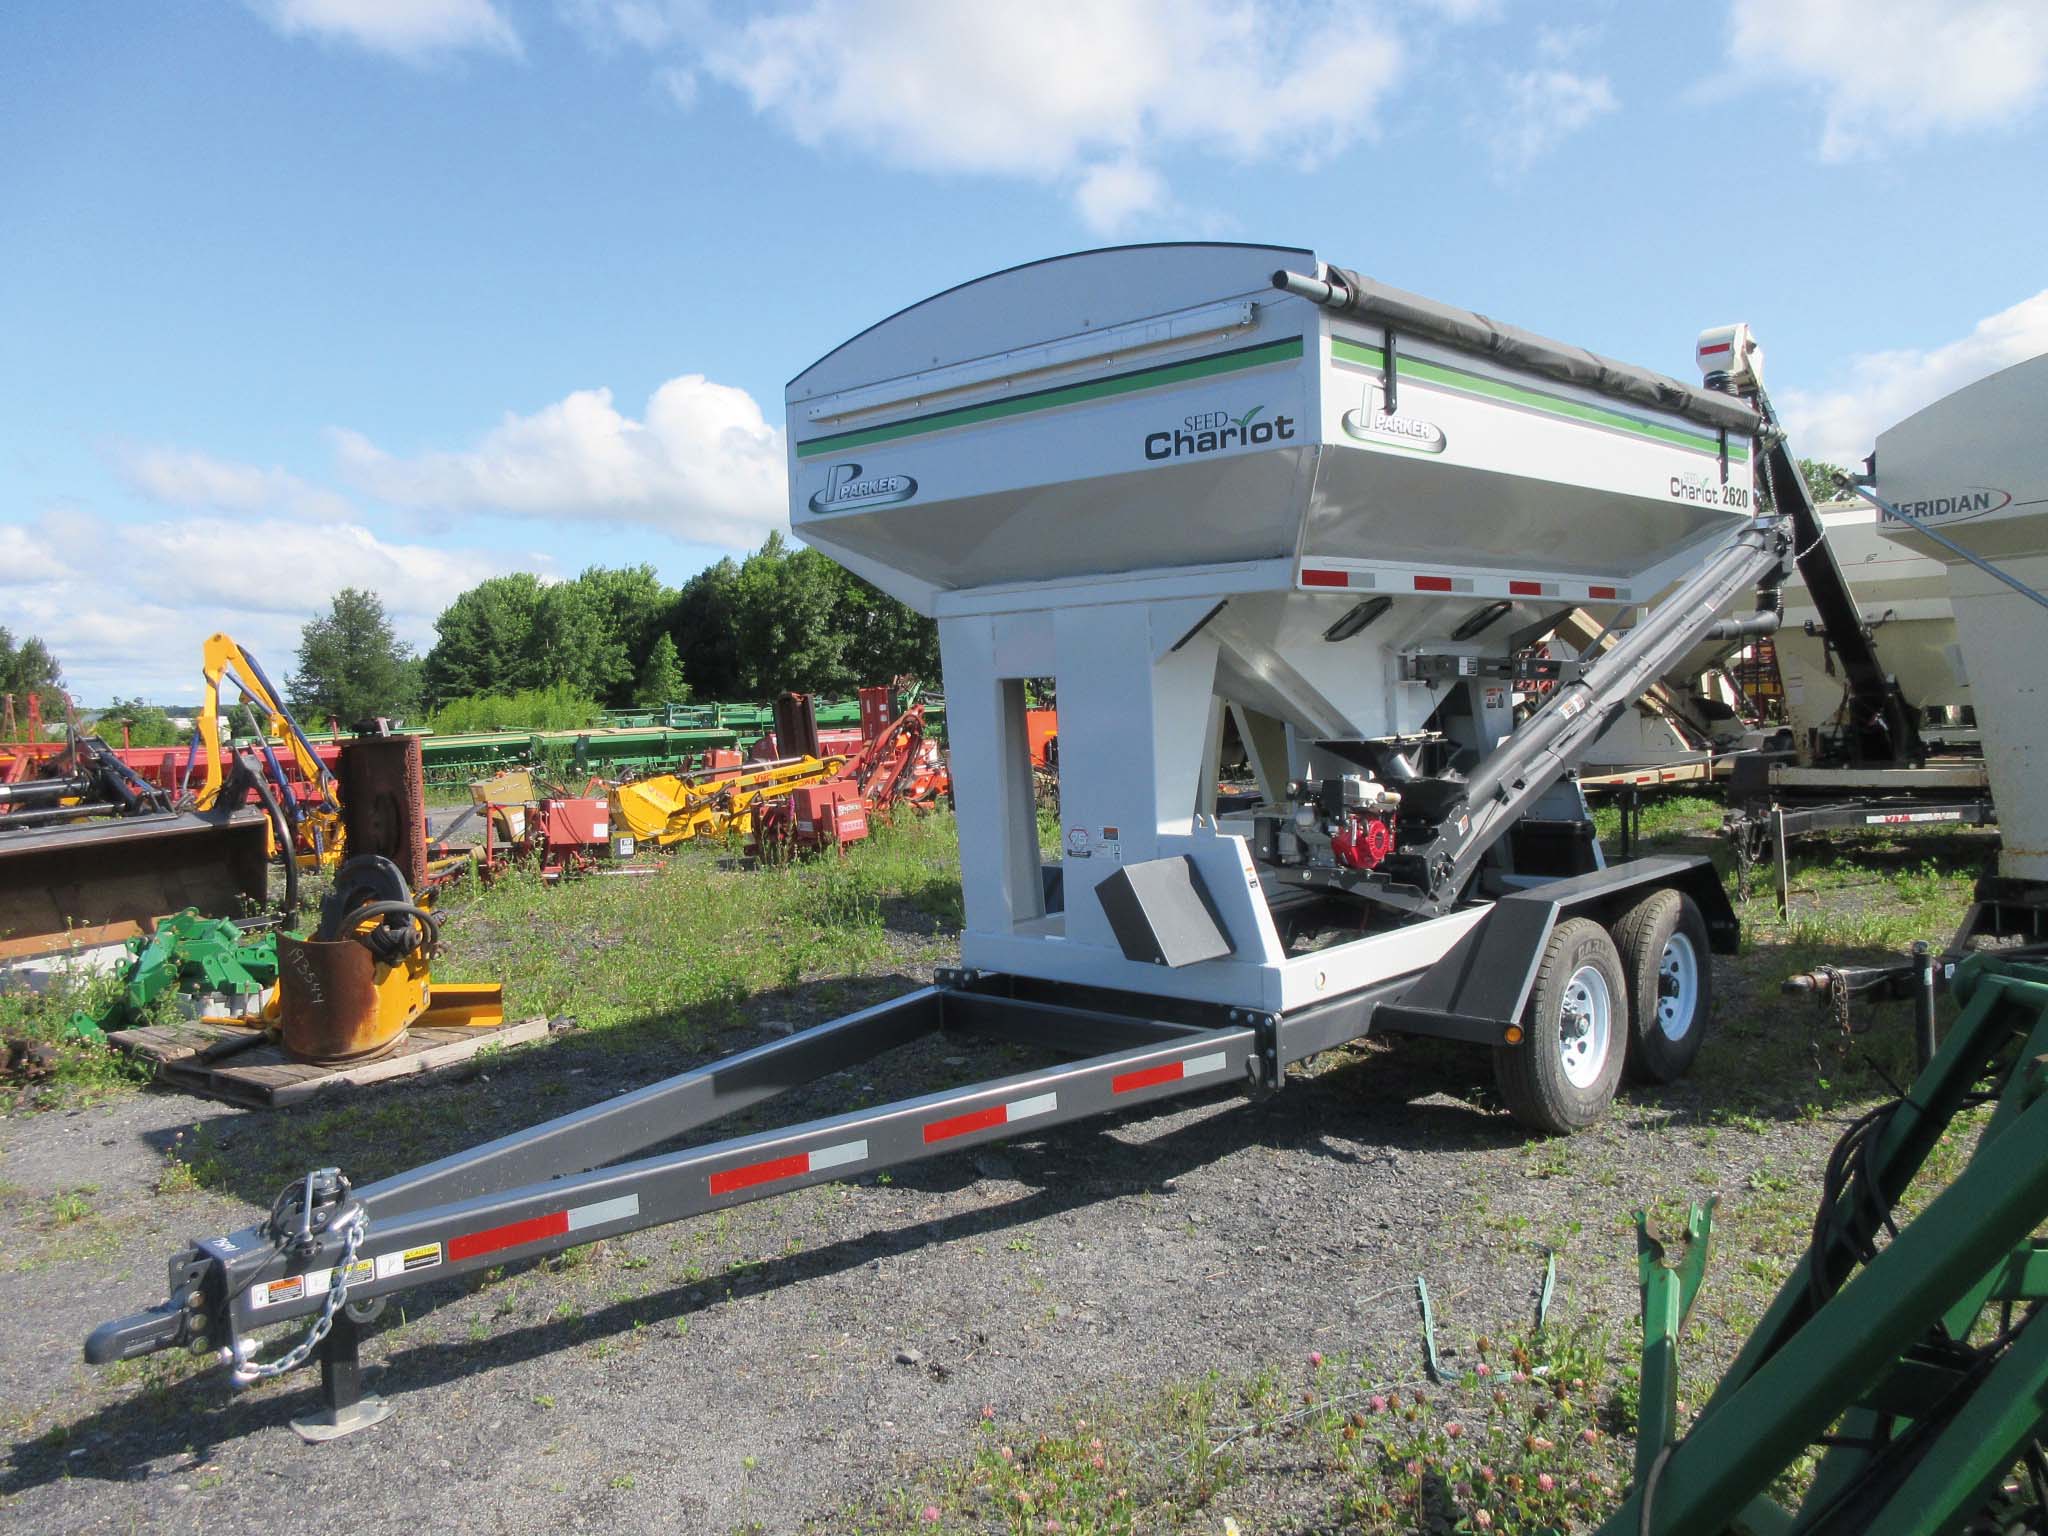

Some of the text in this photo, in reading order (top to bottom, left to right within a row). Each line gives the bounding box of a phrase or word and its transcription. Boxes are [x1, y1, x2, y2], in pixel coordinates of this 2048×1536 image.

[1184, 411, 1228, 432] SEED
[1375, 415, 1430, 439] PARKER
[1145, 415, 1295, 460] Chariot
[840, 478, 898, 499] PARKER
[1670, 477, 1748, 508] Chariot 2620
[1881, 493, 1989, 523] MERIDIAN
